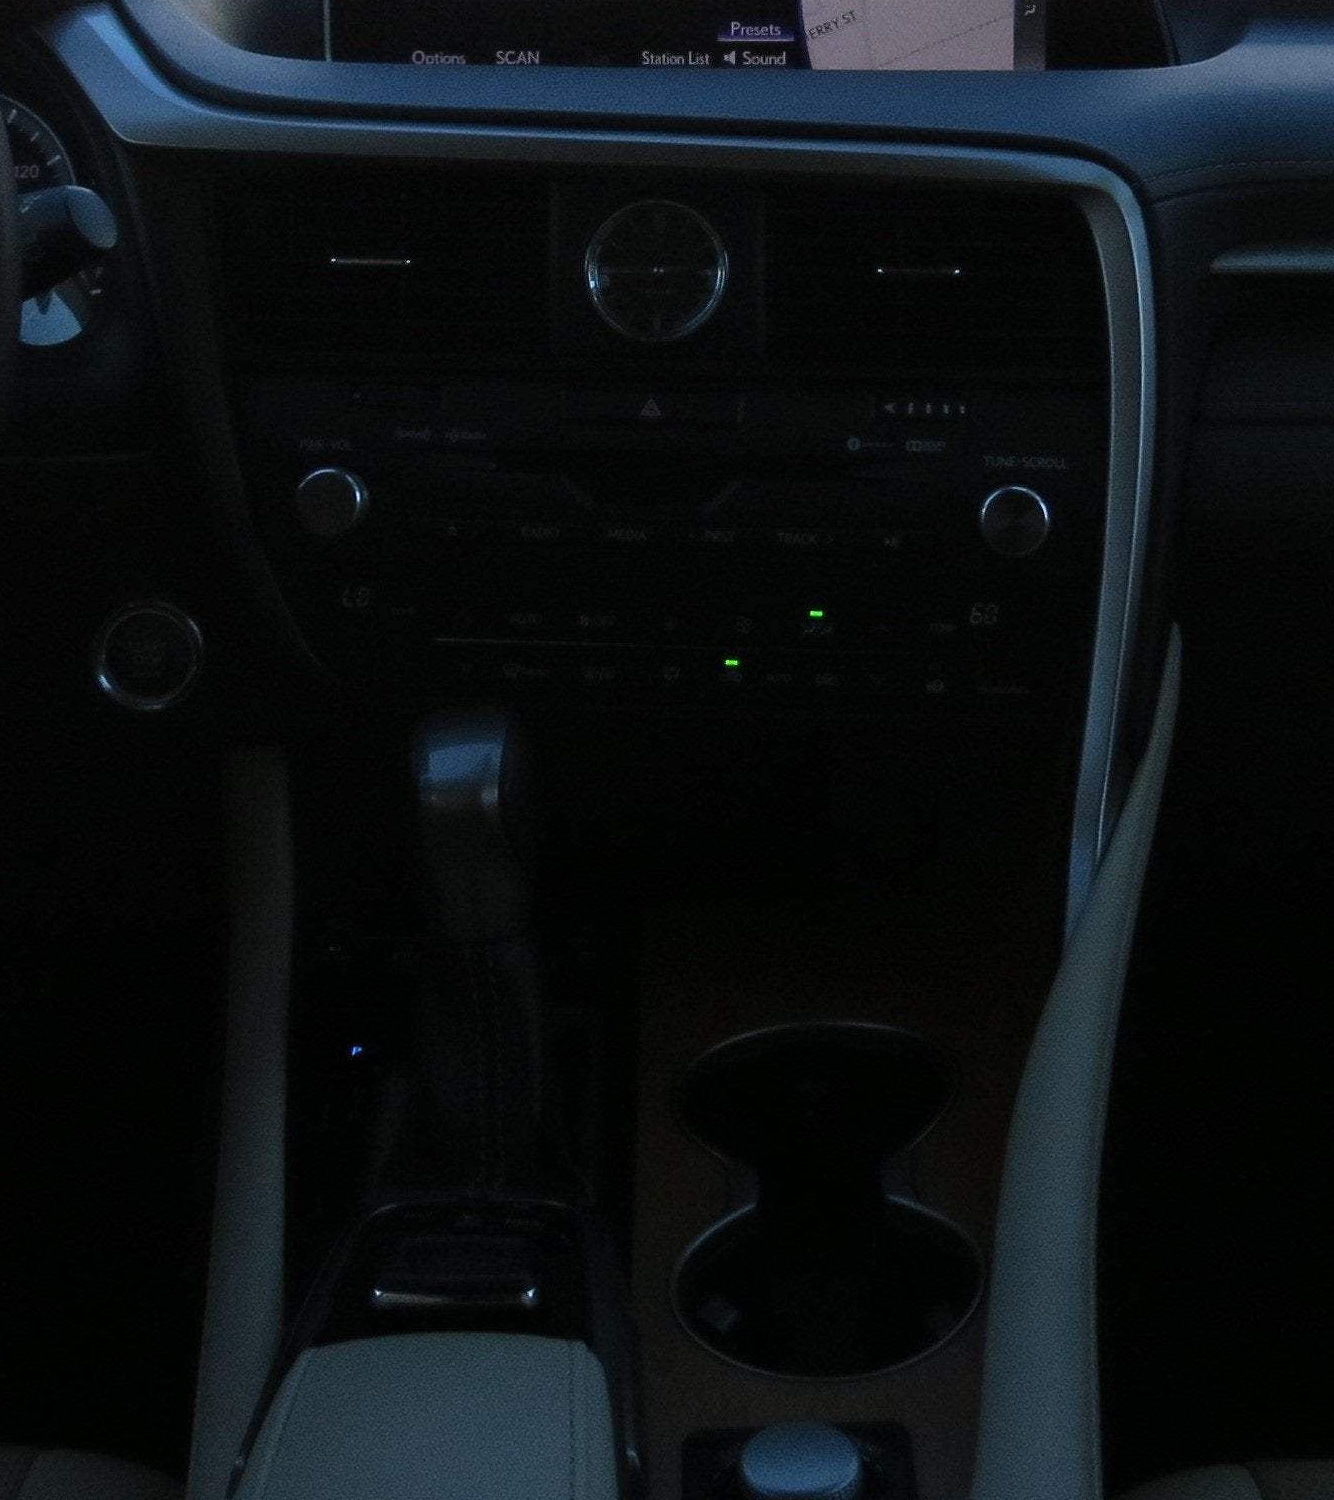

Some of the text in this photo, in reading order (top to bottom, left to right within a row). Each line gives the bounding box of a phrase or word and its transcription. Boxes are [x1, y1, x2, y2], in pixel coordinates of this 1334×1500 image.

[842, 10, 858, 24] ST
[730, 22, 782, 39] Presets
[412, 50, 466, 65] Options
[496, 50, 540, 65] SCAN
[641, 50, 710, 66] Station List
[742, 50, 787, 66] Sound
[969, 602, 1000, 626] 60
